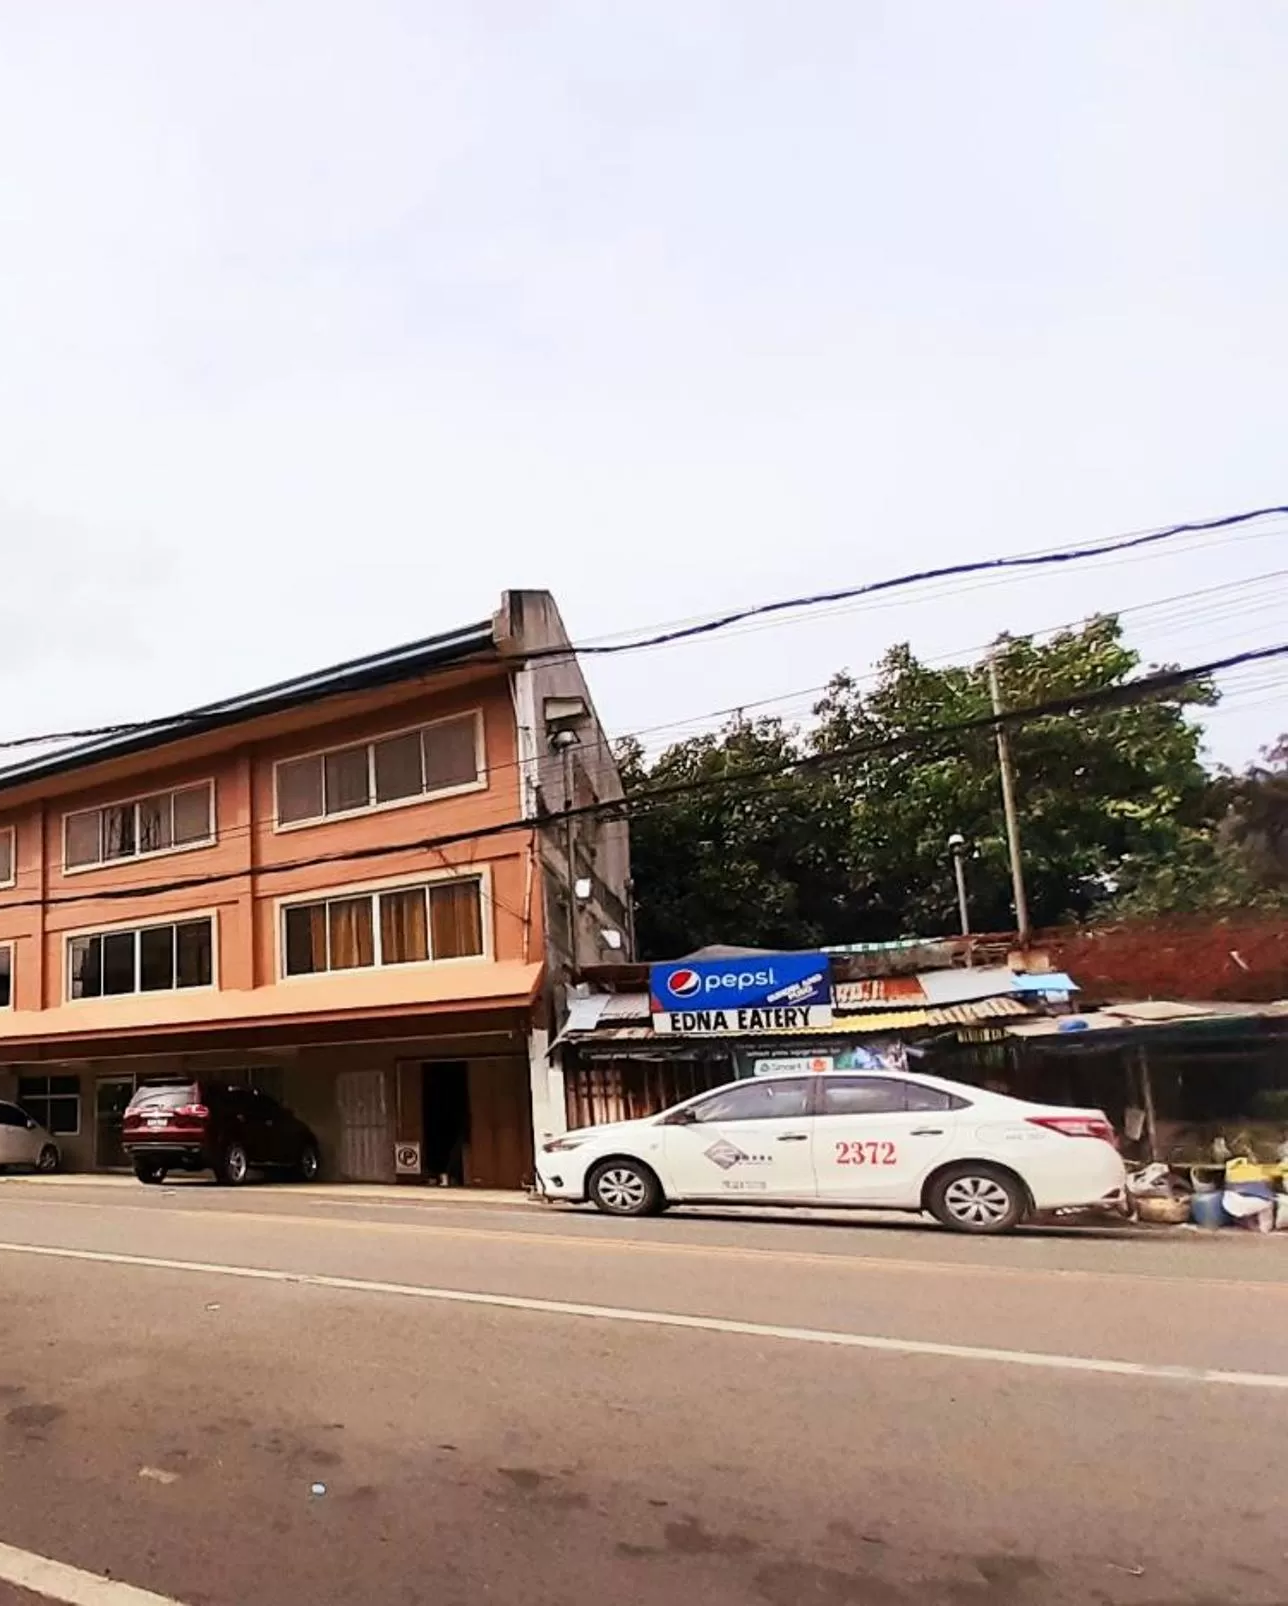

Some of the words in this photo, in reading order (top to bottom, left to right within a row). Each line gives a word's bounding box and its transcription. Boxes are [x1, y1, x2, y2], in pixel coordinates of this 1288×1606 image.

[705, 967, 774, 993] pepsi
[670, 1011, 729, 1031] EDNA
[737, 1006, 811, 1030] EATERY
[835, 1142, 897, 1165] 2372
